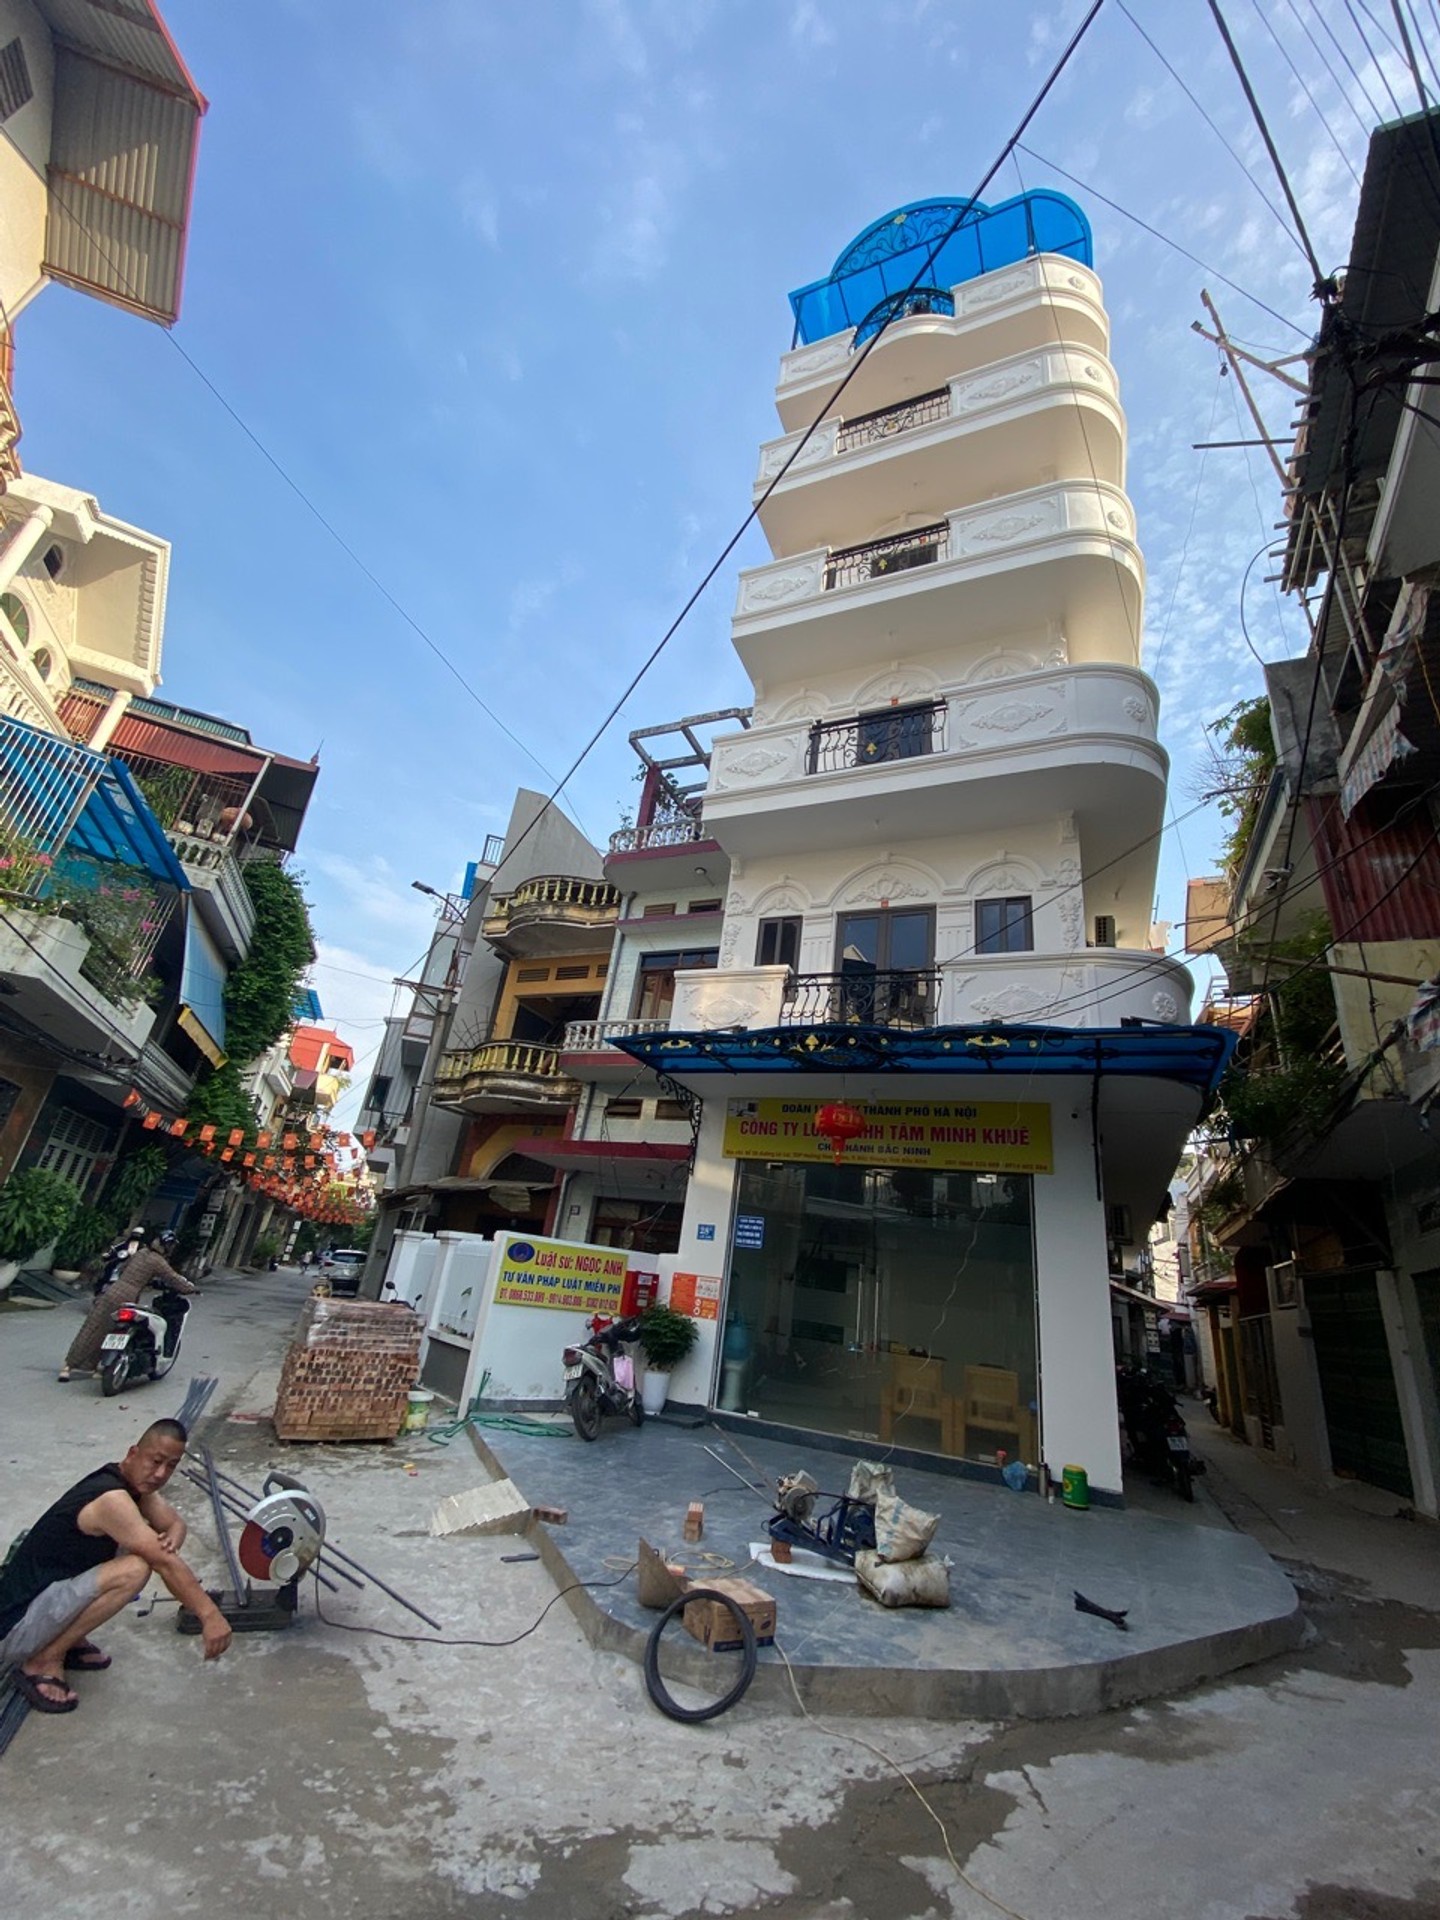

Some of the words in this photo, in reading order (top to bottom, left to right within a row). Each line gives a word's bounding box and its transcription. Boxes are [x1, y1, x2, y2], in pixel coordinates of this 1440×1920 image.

[784, 1122, 799, 1137] TY
[930, 1126, 976, 1143] MINH
[575, 1255, 603, 1277] NGỌC
[603, 1259, 625, 1277] ANH
